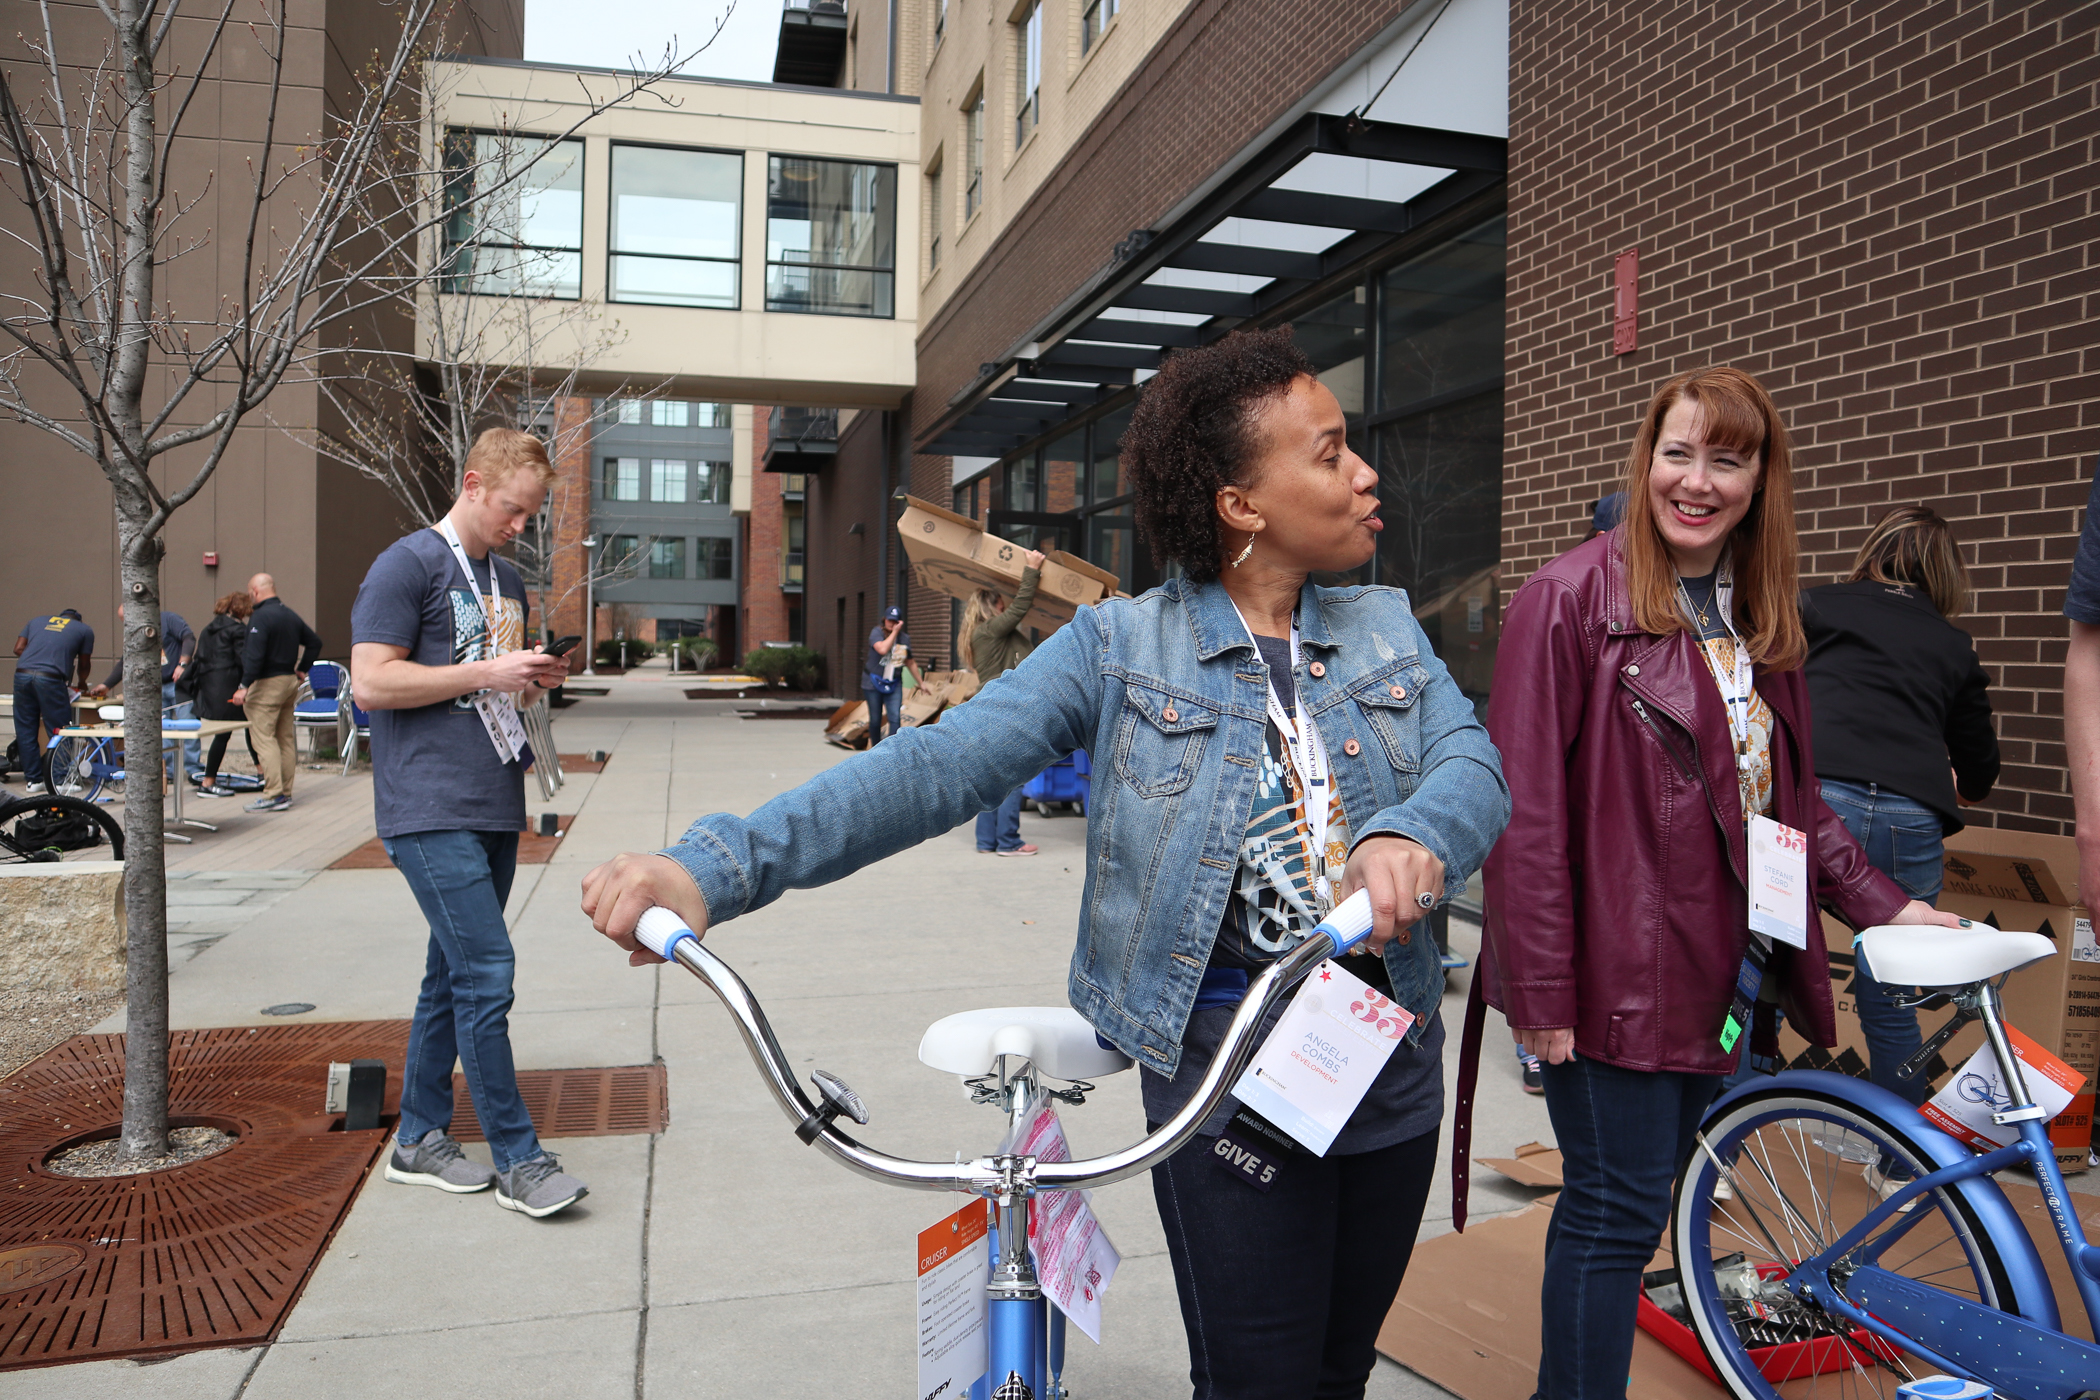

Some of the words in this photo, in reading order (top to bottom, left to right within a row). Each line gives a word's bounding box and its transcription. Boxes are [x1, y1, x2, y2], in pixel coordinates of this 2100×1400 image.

[1305, 722, 1319, 777] BUCKINGHAM
[1763, 864, 1795, 883] STEFANIE
[1770, 875, 1789, 888] CORD
[1950, 881, 1985, 895] MAKE
[1331, 1010, 1387, 1050] CELEBRATE
[1350, 988, 1415, 1039] 35
[1302, 1043, 1341, 1074] COMBS
[1304, 1032, 1349, 1066] ANGELA
[1290, 1051, 1338, 1085] DEVELOPMENT
[1236, 1112, 1263, 1131] AWARD
[1262, 1127, 1294, 1150] NOMINEE
[1927, 1106, 1941, 1117] FREE
[1939, 1115, 1966, 1134] ASSEMBLY
[2055, 1115, 2074, 1126] SLOT#
[2076, 1115, 2088, 1126] 525
[1214, 1139, 1262, 1175] GIVE
[1260, 1164, 1277, 1183] 5
[2036, 1161, 2055, 1197] PERFECT
[2053, 1208, 2073, 1244] FRAME
[921, 1246, 948, 1270] CRUISER
